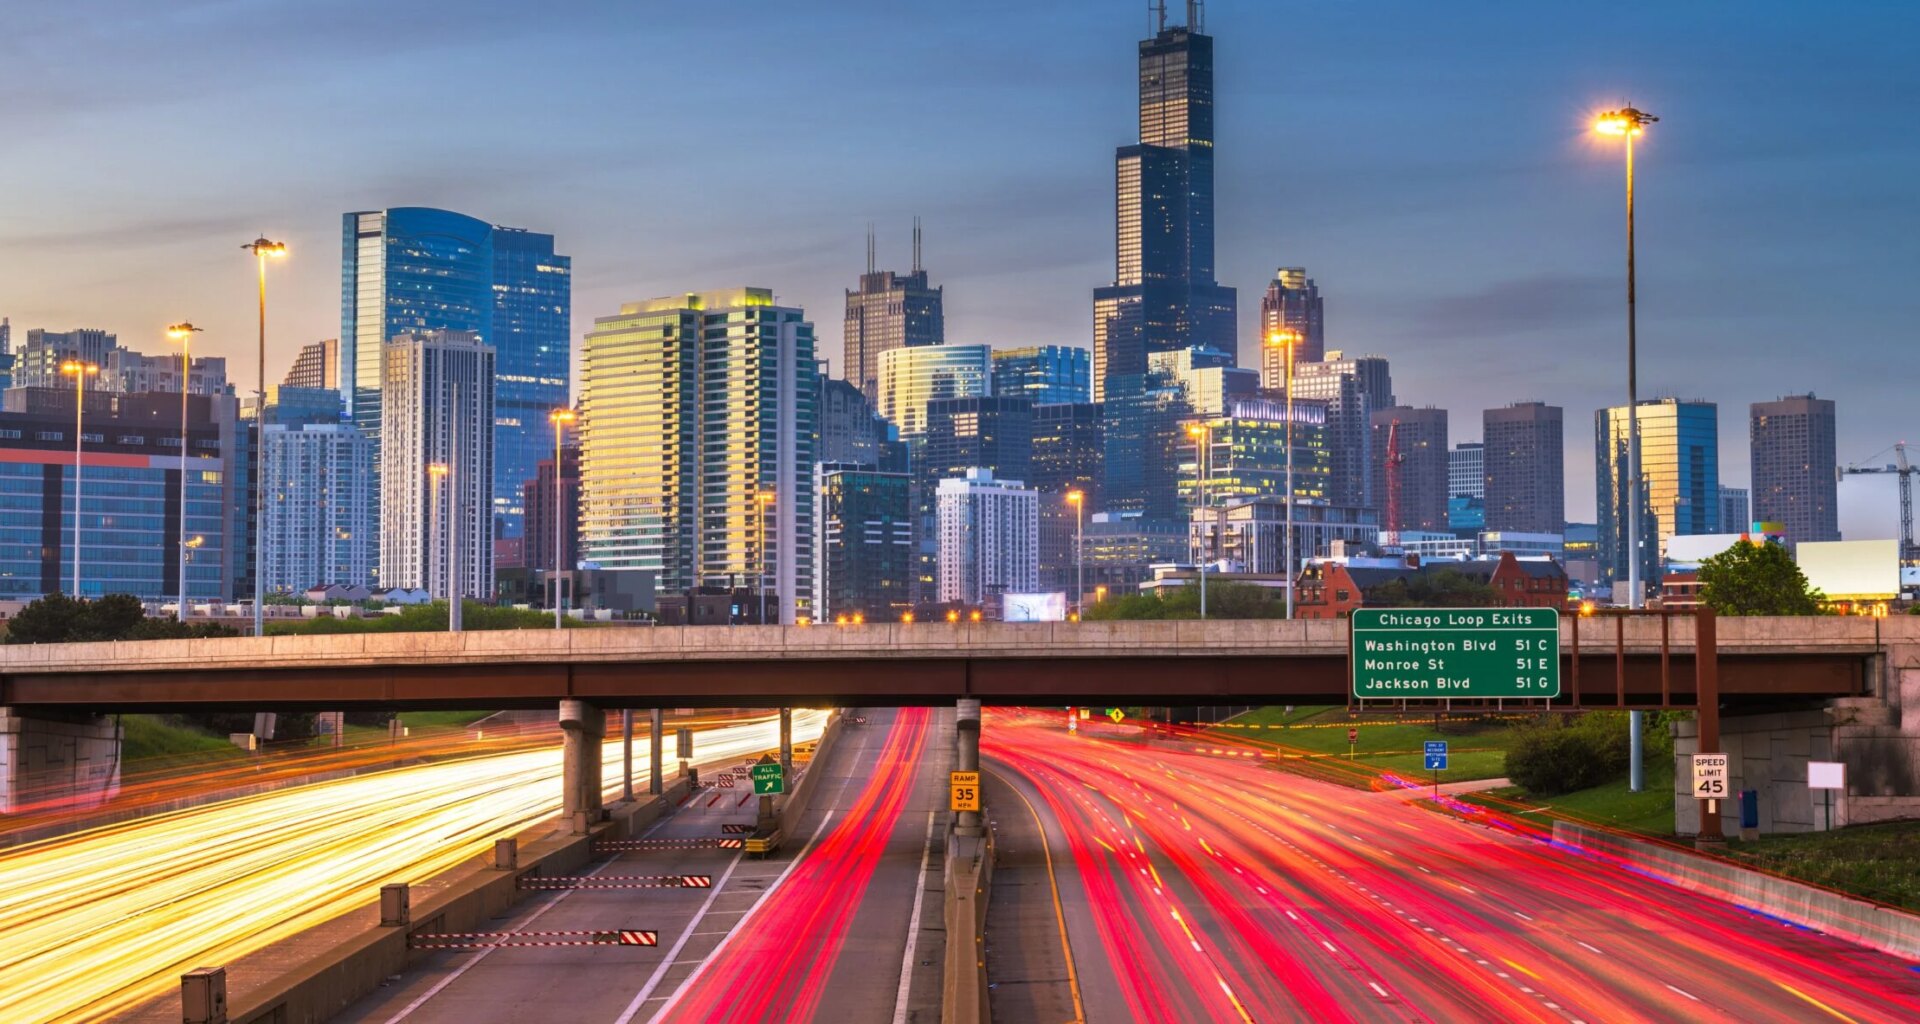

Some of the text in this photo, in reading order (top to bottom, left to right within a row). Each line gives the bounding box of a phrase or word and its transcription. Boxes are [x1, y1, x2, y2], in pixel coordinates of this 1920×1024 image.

[1379, 613, 1532, 628] Chicago Loop Exits
[1365, 639, 1547, 654] Washington Blvd 51 C
[1365, 658, 1548, 670] Monroe St 51 E
[1366, 677, 1548, 689] Jackson Blvd 51 G
[1695, 758, 1725, 766] SPEED
[754, 773, 782, 781] TRAFFIC
[1698, 769, 1722, 777] LIMIT
[1698, 780, 1723, 793] 45
[956, 788, 974, 800] 35
